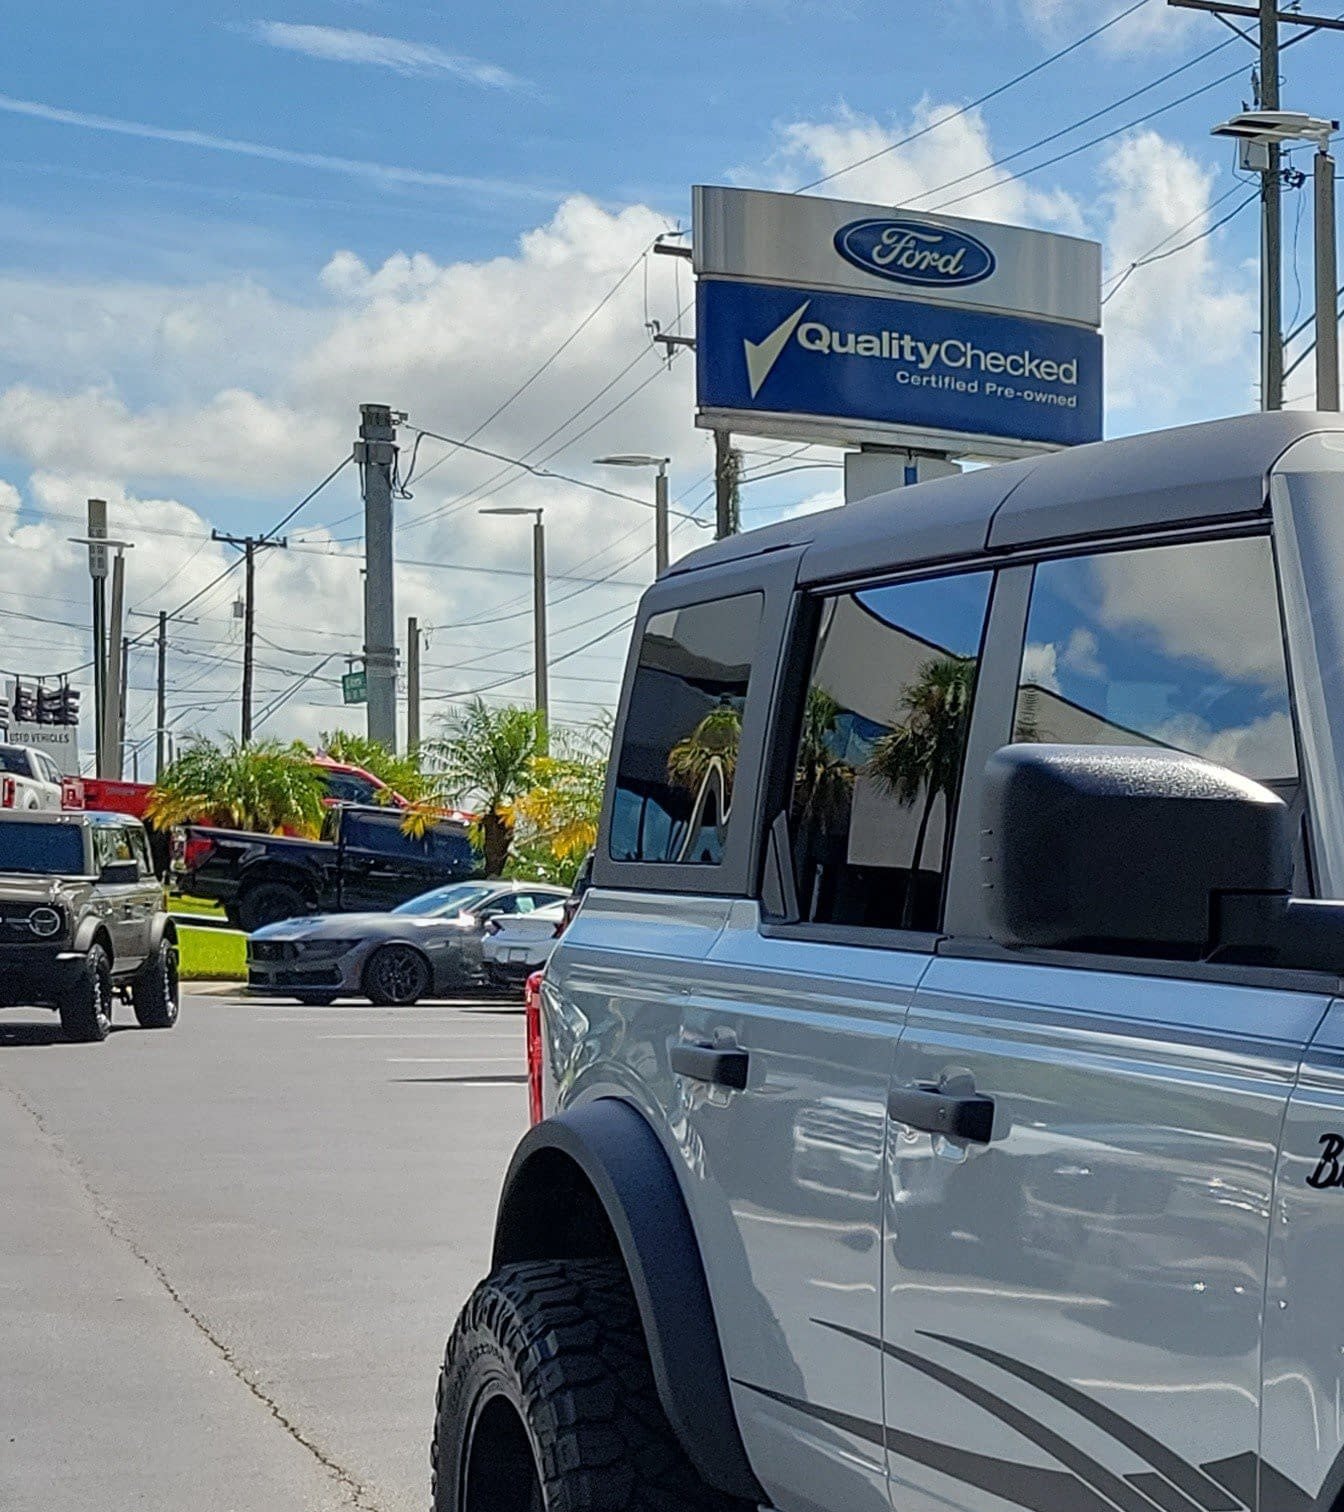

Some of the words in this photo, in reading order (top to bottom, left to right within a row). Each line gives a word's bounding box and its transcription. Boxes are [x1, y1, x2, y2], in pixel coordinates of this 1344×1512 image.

[872, 228, 966, 275] Ford
[797, 322, 1078, 385] QualityChecked
[896, 371, 979, 393] Certified
[985, 382, 1078, 408] Pre-owned
